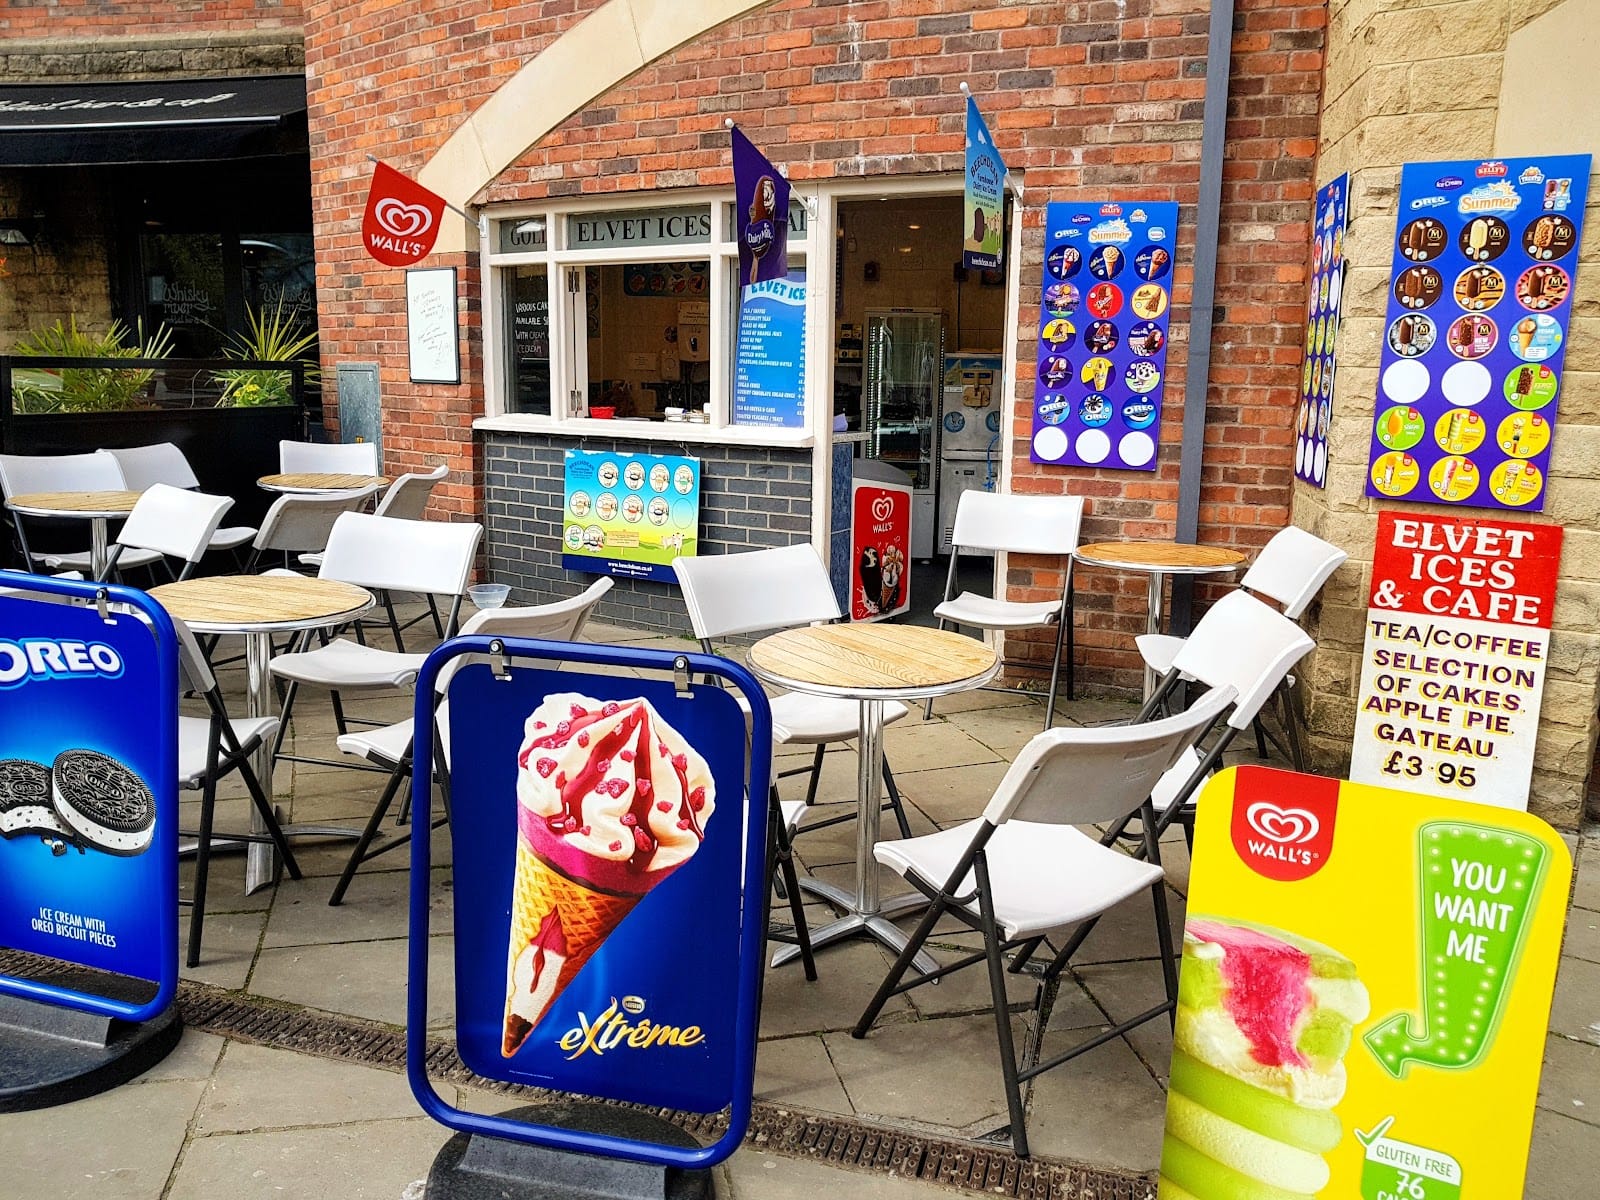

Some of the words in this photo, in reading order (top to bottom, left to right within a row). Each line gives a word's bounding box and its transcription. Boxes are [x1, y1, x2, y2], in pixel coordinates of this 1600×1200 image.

[1461, 196, 1518, 211] Summer
[577, 218, 651, 242] ELVET
[656, 214, 711, 238] ICES
[1090, 229, 1130, 241] Summer
[371, 233, 422, 257] WALL'S
[788, 287, 806, 300] ICE
[1392, 519, 1534, 559] ELVET
[1410, 553, 1515, 590] ICES
[1373, 579, 1404, 609] &
[1422, 585, 1541, 625] CAFE
[0, 641, 121, 683] OREO
[1374, 649, 1535, 689] SELECTION
[1376, 674, 1411, 694] OF
[1364, 695, 1452, 724] APPLE
[1247, 839, 1312, 865] WALL'S
[1451, 857, 1507, 894] YOU
[40, 907, 52, 921] ICE
[55, 910, 83, 927] CREAM
[84, 916, 106, 933] WITH
[1434, 891, 1514, 933] WANT
[31, 918, 54, 934] OREO
[56, 923, 87, 941] BISCUIT
[89, 930, 117, 948] PIECES
[1446, 929, 1489, 964] ME
[1376, 1144, 1421, 1168] GLUTEN
[1424, 1158, 1453, 1177] FREE
[1396, 1169, 1426, 1200] 76
